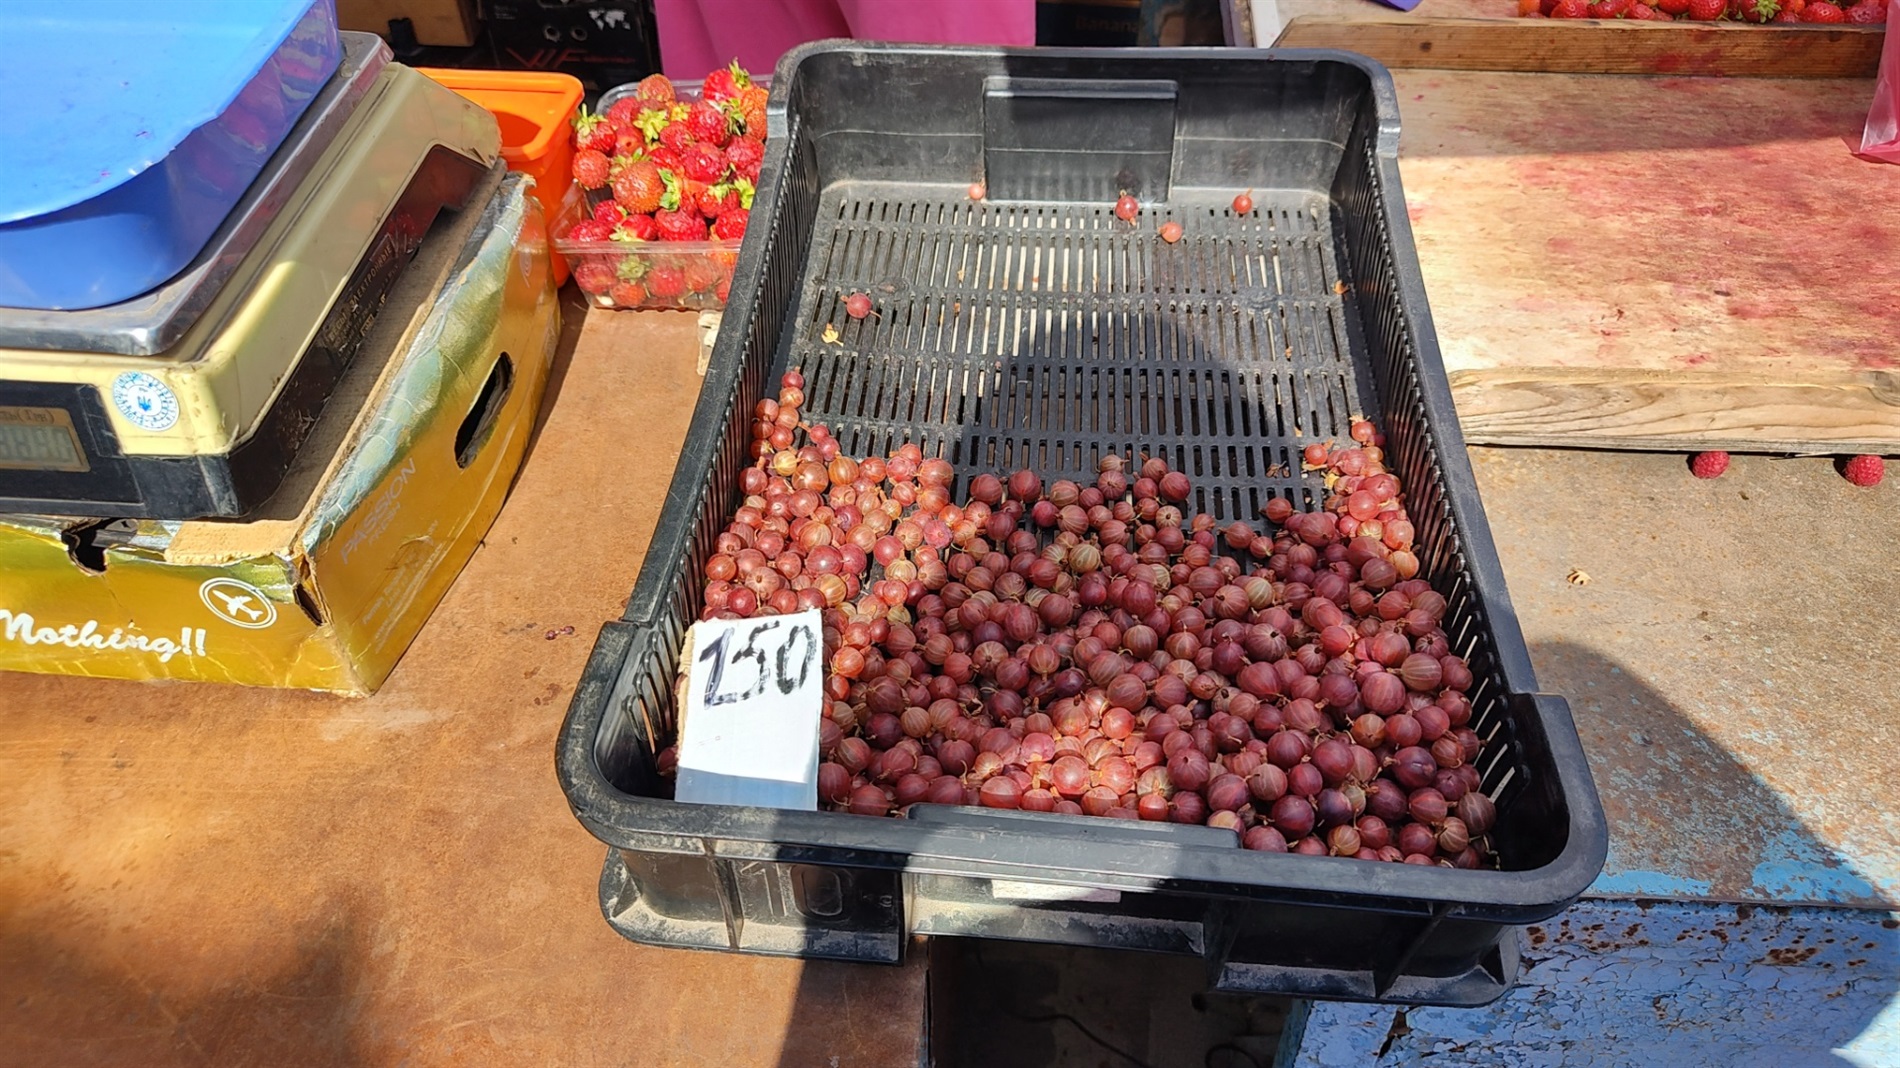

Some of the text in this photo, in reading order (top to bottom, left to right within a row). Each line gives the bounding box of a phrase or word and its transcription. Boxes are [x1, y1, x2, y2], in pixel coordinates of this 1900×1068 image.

[340, 457, 417, 565] PASSION
[0, 609, 207, 663] Nothing!!
[698, 620, 818, 710] 150
